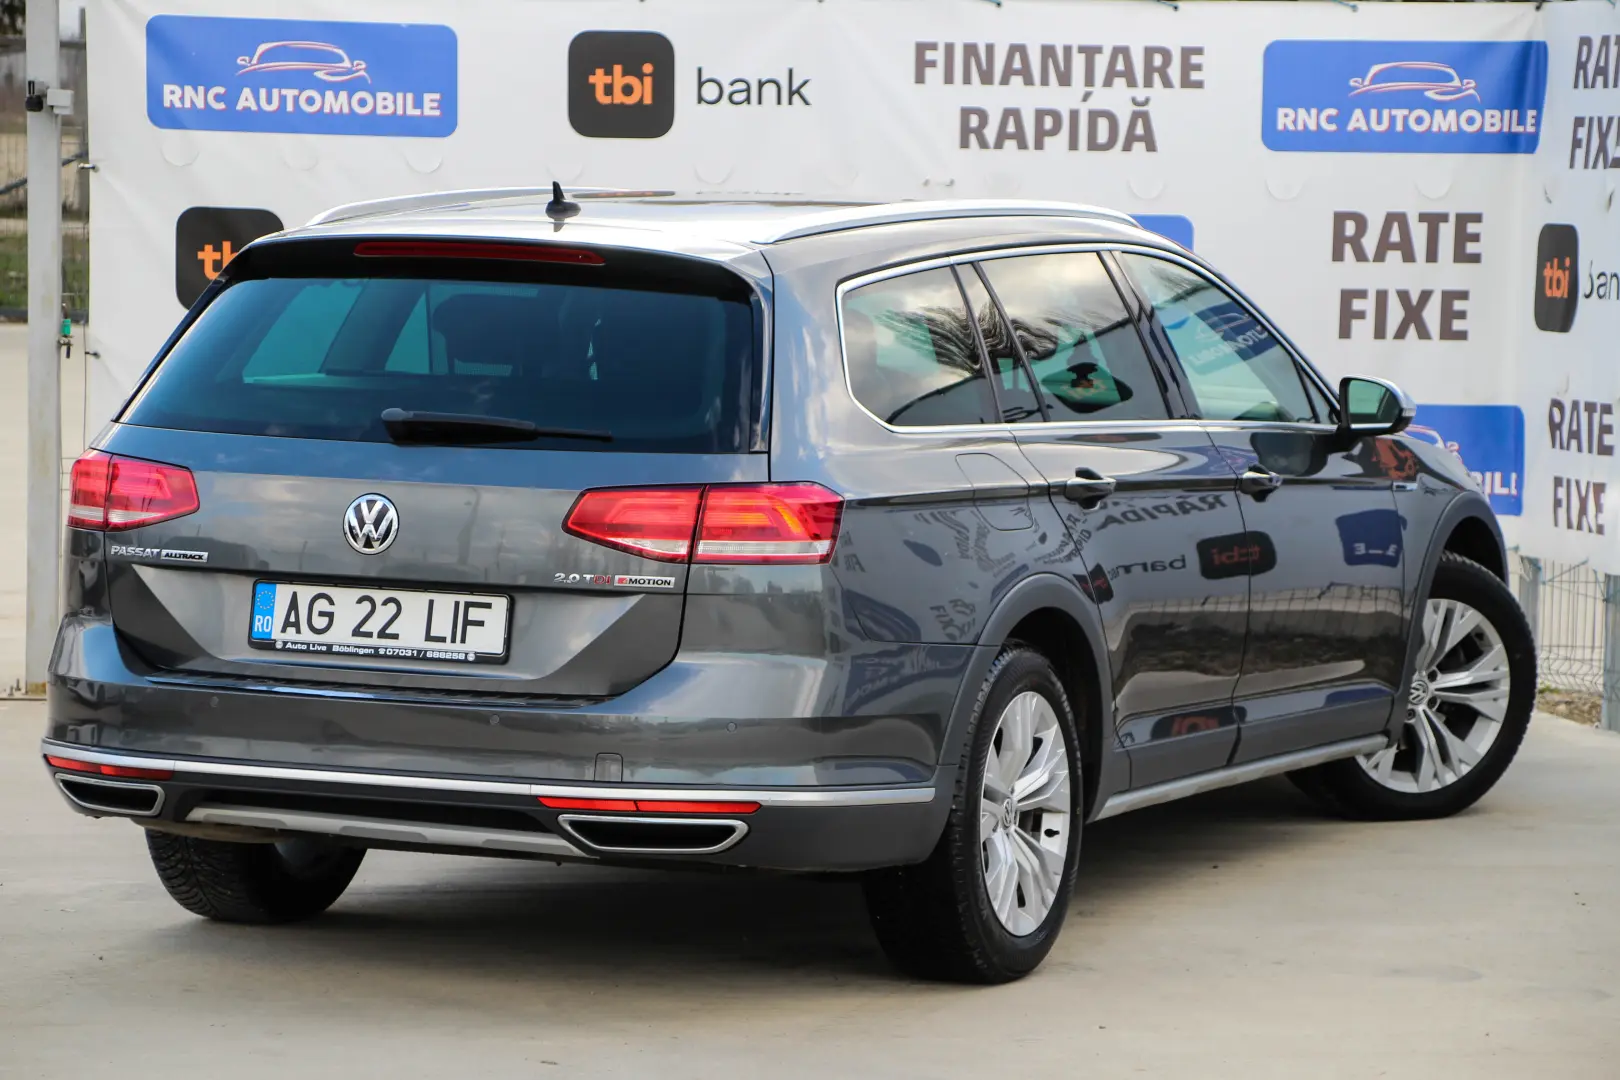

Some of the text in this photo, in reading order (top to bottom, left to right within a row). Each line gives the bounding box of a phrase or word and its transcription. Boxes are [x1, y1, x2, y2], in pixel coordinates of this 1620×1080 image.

[163, 84, 441, 116] RNC AUTOMOBILE
[588, 63, 812, 105] tbi bank
[1276, 107, 1537, 133] RNC AUTOMOBILE
[1331, 211, 1483, 264] RATE
[1543, 256, 1571, 298] tbi
[1338, 289, 1470, 341] FIXE
[1549, 398, 1615, 456] RATE
[1553, 476, 1607, 535] FIXE
[111, 545, 204, 560] PASSAT ALLTRACK
[551, 572, 580, 584] 2.0
[583, 574, 611, 585] TDI
[254, 615, 272, 633] RO
[280, 591, 492, 644] AG 22 LIF
[285, 642, 307, 650] Auto
[310, 643, 327, 651] Live
[332, 645, 374, 655] Böblingen
[386, 648, 417, 657] 07031
